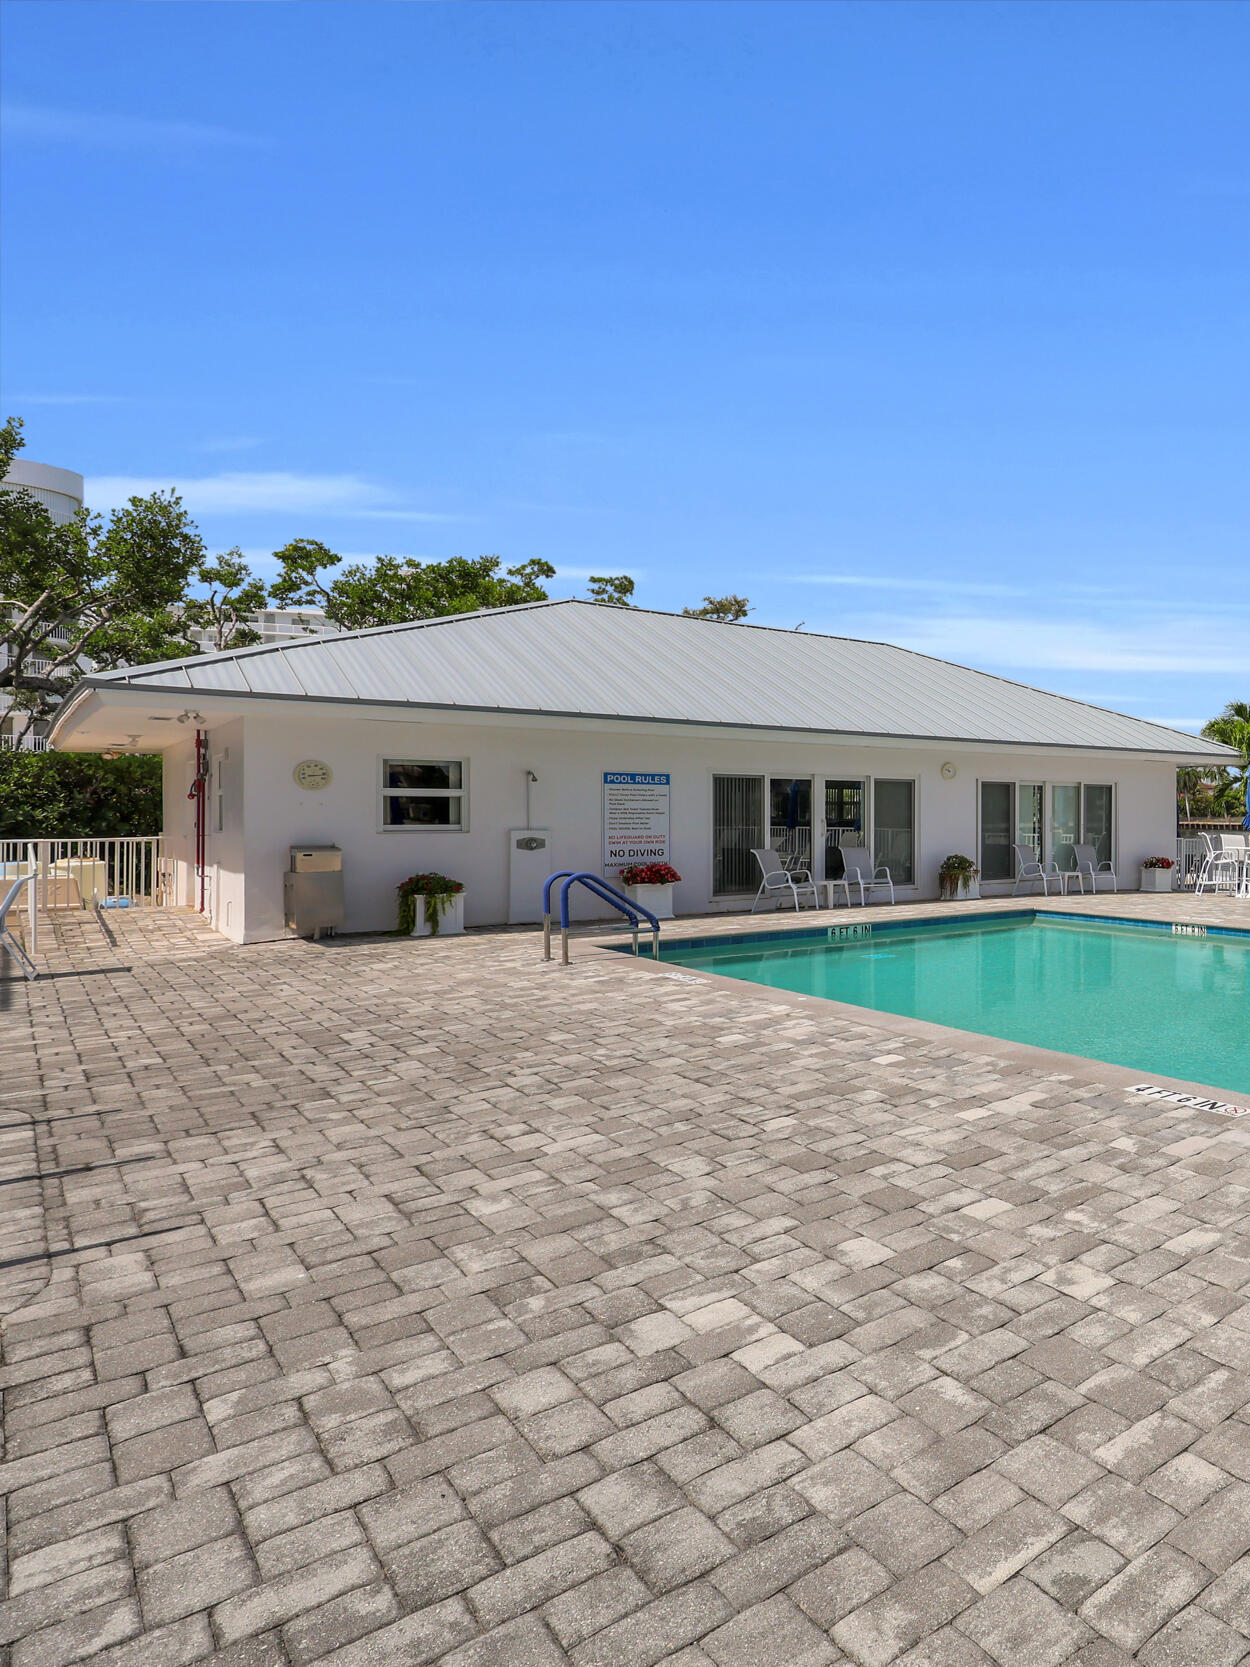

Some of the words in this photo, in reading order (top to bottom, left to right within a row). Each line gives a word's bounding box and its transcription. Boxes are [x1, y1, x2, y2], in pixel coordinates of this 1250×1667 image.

[607, 775, 633, 783] POOL
[635, 775, 667, 784] RULES
[610, 849, 625, 857] NO
[628, 848, 665, 857] DIVING
[1147, 1089, 1182, 1099] FT
[1193, 1100, 1227, 1110] IN
